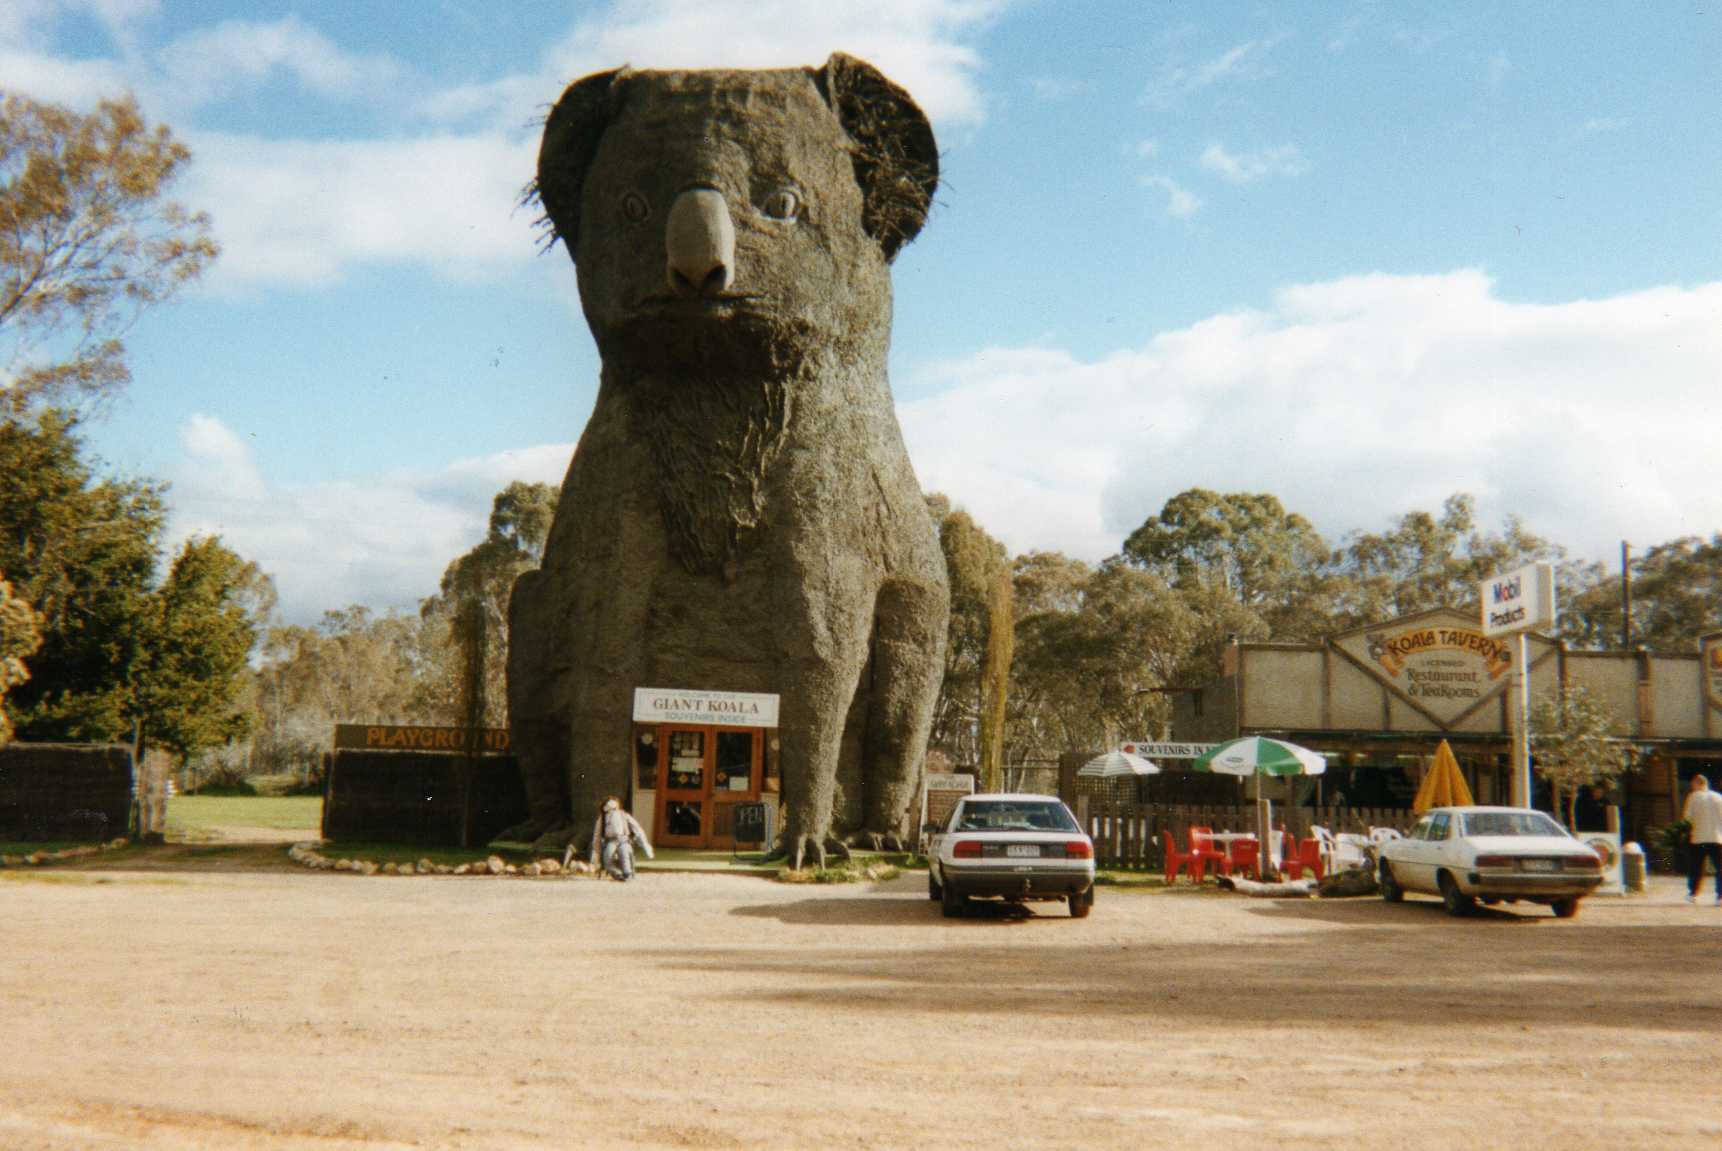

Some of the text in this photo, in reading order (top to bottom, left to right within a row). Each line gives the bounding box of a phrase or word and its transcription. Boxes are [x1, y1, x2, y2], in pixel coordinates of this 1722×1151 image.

[1388, 630, 1501, 658] KOALA TAVERN
[1407, 668, 1478, 682] Restaurant
[652, 697, 760, 714] GIANT KOALA
[366, 727, 510, 748] PLAYGROND
[1139, 745, 1191, 755] SOUVENIRS
